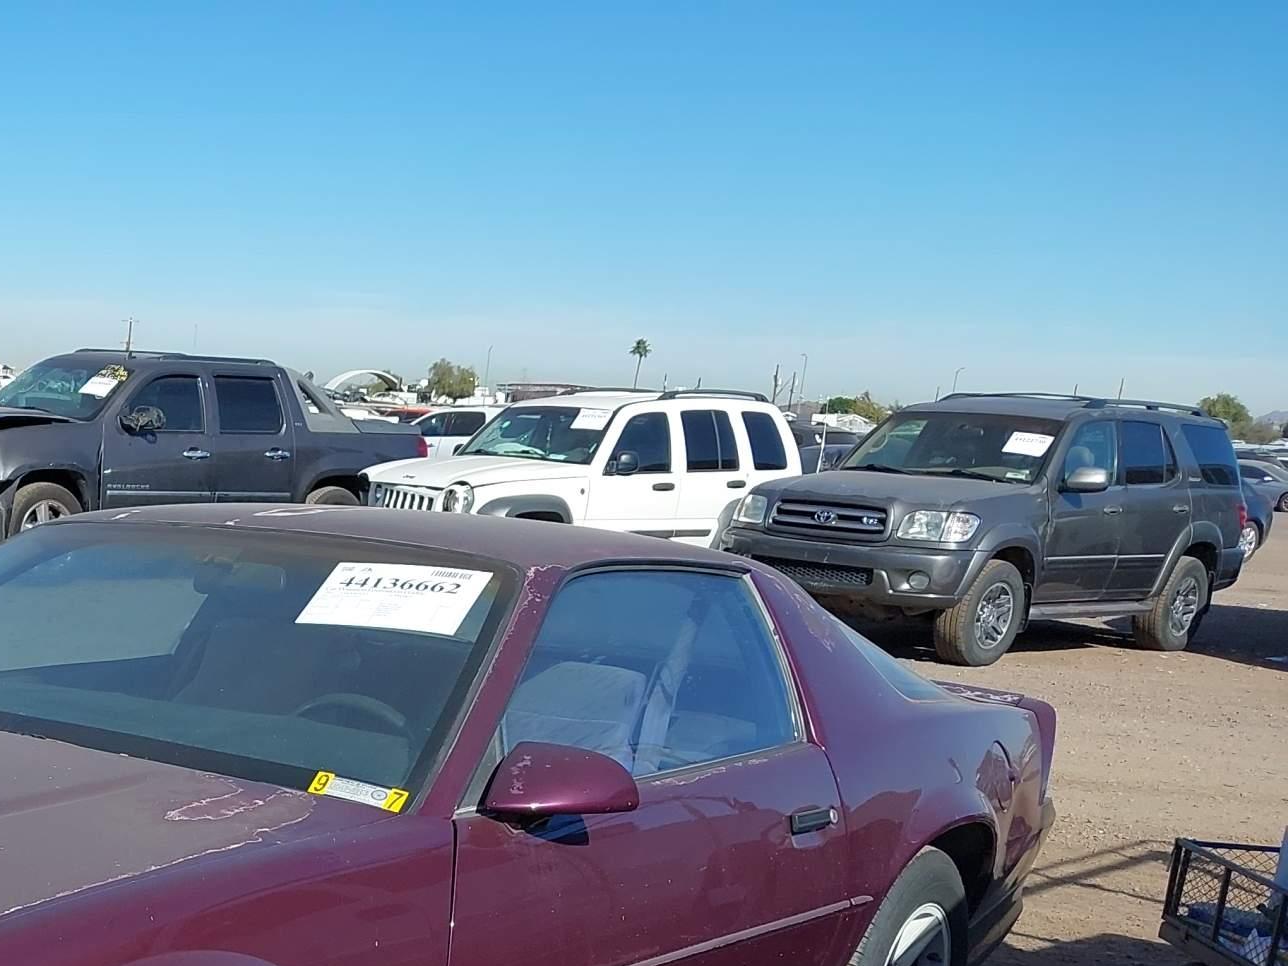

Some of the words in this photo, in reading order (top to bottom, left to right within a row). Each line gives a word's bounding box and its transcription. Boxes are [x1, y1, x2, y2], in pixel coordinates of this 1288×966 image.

[339, 575, 462, 595] 44136662
[313, 774, 330, 792] 9
[387, 791, 404, 809] 7
